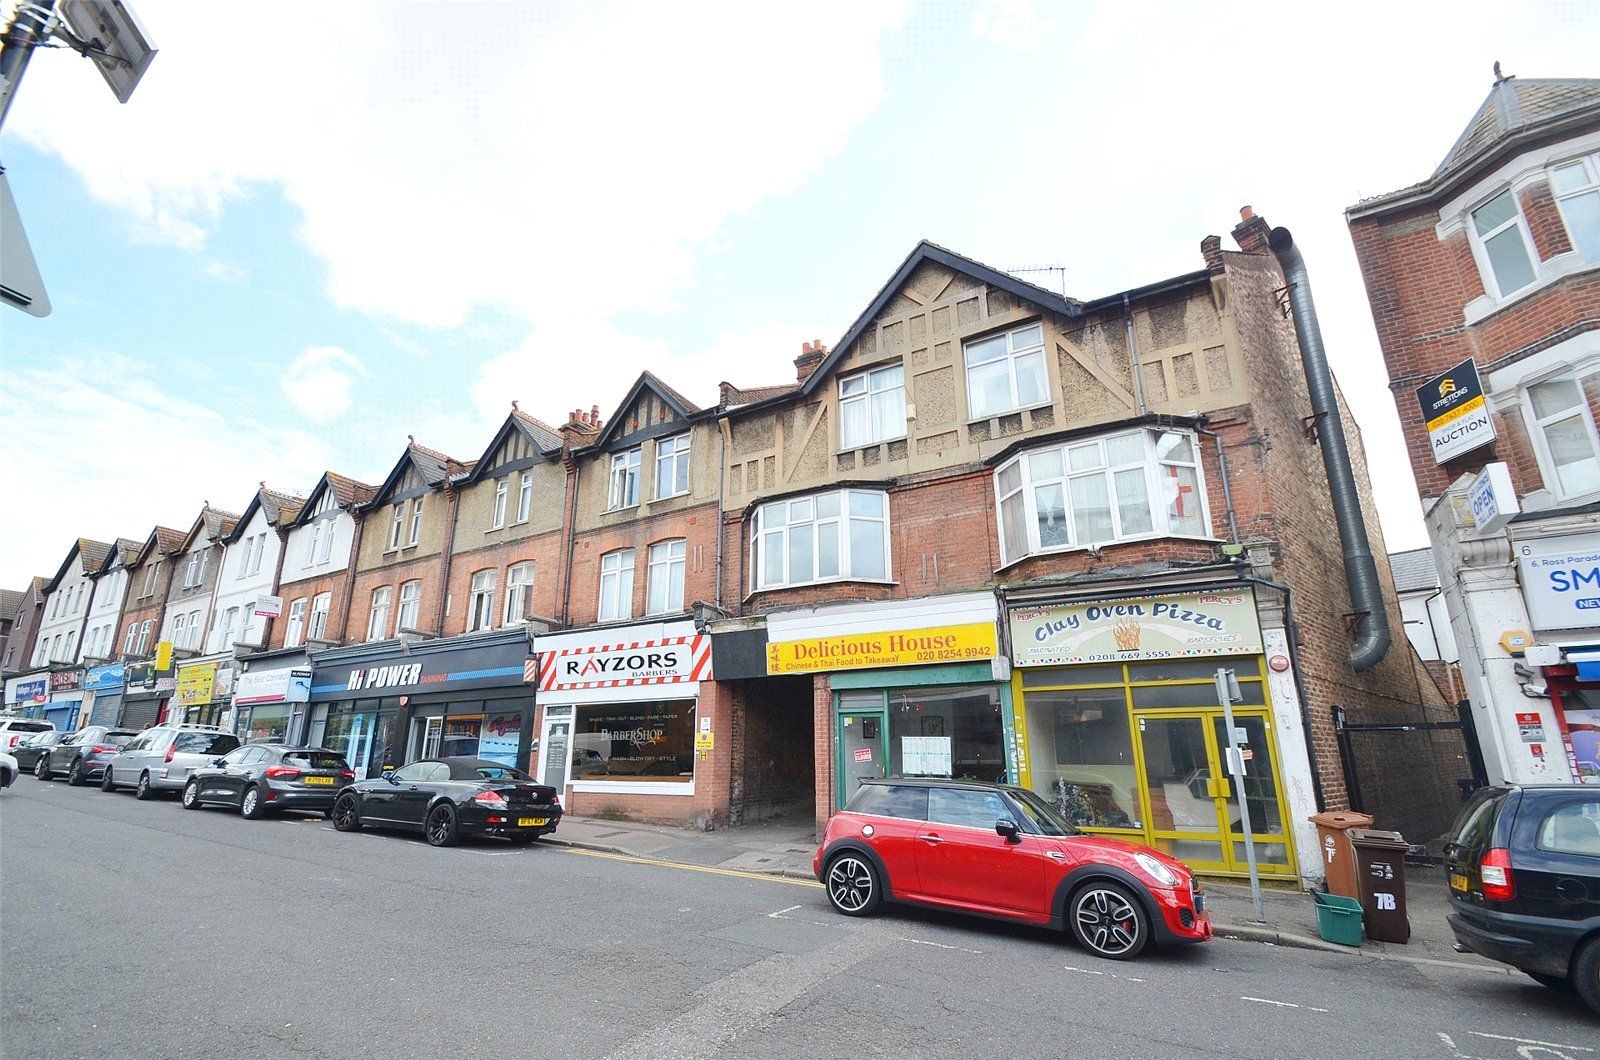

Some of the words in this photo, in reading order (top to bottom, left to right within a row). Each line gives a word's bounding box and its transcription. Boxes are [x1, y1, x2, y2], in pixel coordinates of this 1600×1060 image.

[1433, 386, 1468, 410] STRETTONS
[1435, 416, 1487, 447] AUCTION
[1473, 485, 1493, 516] OPEN
[1521, 545, 1531, 555] 6
[1200, 595, 1242, 604] PERCY'S
[1017, 610, 1051, 621] PERCY'S
[1035, 614, 1080, 641] Clay
[1086, 604, 1145, 621] Oven
[1153, 602, 1222, 630] Pizza
[794, 640, 882, 660] Delicious
[889, 634, 957, 653] House
[917, 651, 934, 661] 020
[938, 649, 962, 660] 8254
[965, 646, 990, 657] 9942
[566, 652, 678, 677] RAYZORS
[786, 662, 812, 671] Chinese
[813, 660, 819, 668] &
[836, 657, 854, 666] Food
[855, 657, 863, 665] to
[864, 655, 900, 664] Takeaway
[1089, 653, 1115, 661] 0208
[1121, 652, 1139, 660] 669
[1146, 651, 1171, 659] 5555
[347, 669, 365, 691] Hi
[365, 663, 422, 689] POWER
[632, 669, 678, 678] BARBERS
[700, 751, 707, 759] H
[1373, 892, 1396, 910] 7B
